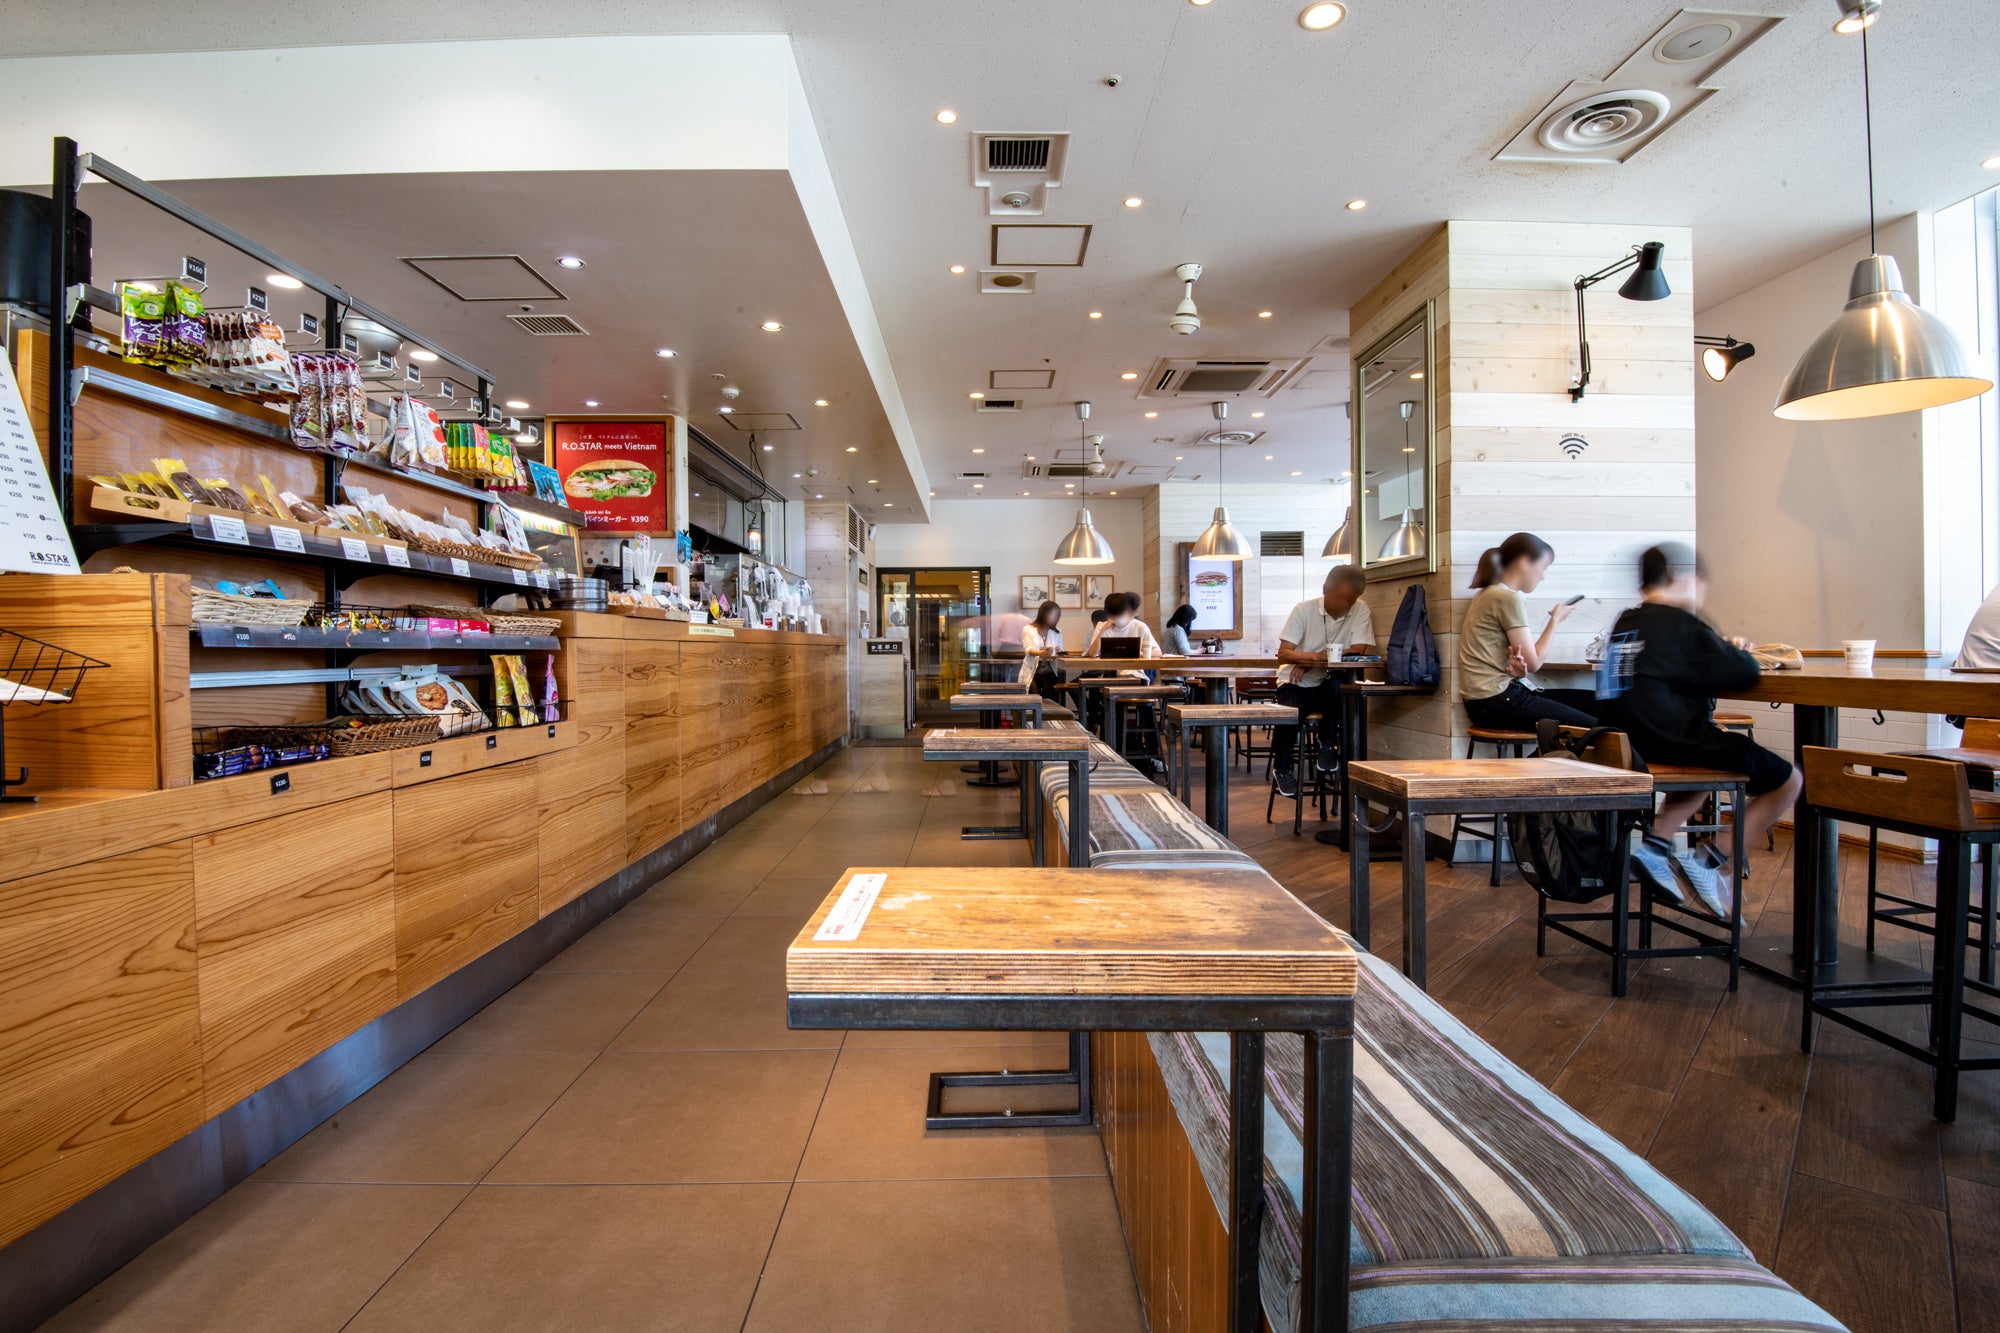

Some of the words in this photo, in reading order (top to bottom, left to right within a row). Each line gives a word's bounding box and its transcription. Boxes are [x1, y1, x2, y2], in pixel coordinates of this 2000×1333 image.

[129, 317, 163, 333] レーズ
[183, 325, 203, 340] チョコ
[562, 442, 602, 450] R.O.STAR
[624, 442, 657, 450] Vietnam
[630, 515, 649, 523] ¥390
